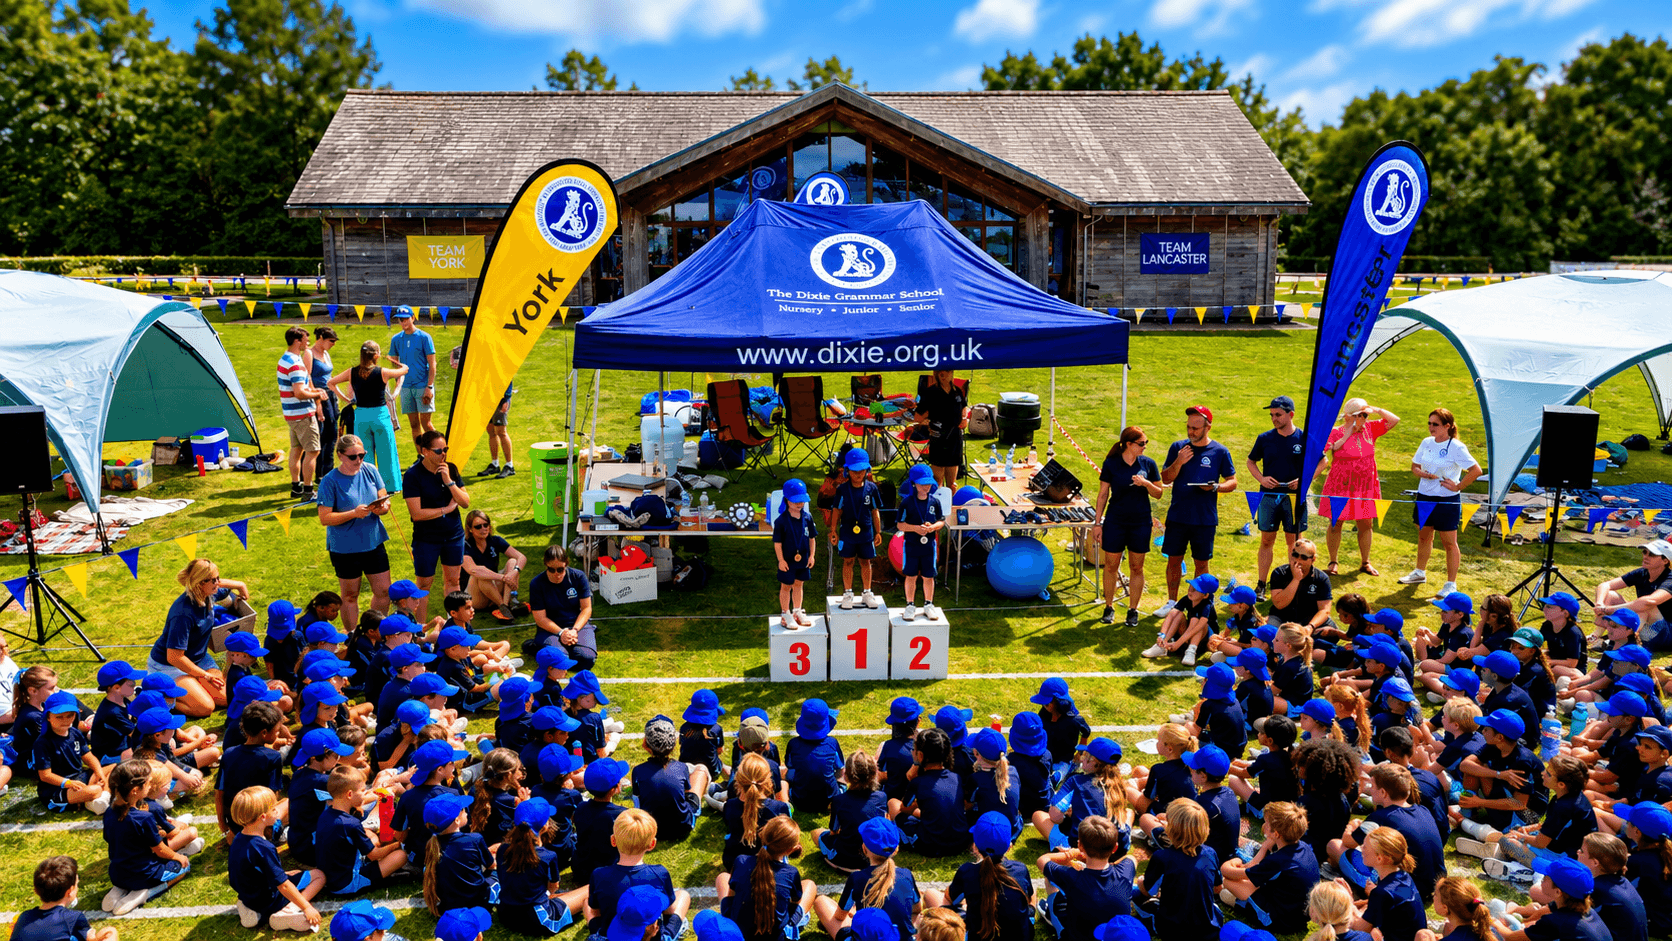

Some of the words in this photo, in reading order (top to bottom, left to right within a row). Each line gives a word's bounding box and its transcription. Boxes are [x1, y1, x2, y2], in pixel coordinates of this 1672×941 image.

[428, 245, 465, 256] TEAM
[1159, 242, 1191, 253] TEAM
[429, 257, 466, 269] YORK
[1143, 253, 1207, 264] LANCASTER
[766, 289, 793, 299] The
[796, 291, 831, 300] Dixie
[834, 292, 896, 301] Grammar
[899, 288, 945, 299] School
[503, 268, 565, 335] York
[778, 304, 823, 315] Nursery
[842, 306, 879, 314] Junior
[899, 303, 936, 312] Senior
[736, 337, 984, 368] www.dixie.org.uk
[847, 628, 868, 669] 1
[909, 636, 932, 670] 2
[789, 642, 811, 676] 3
